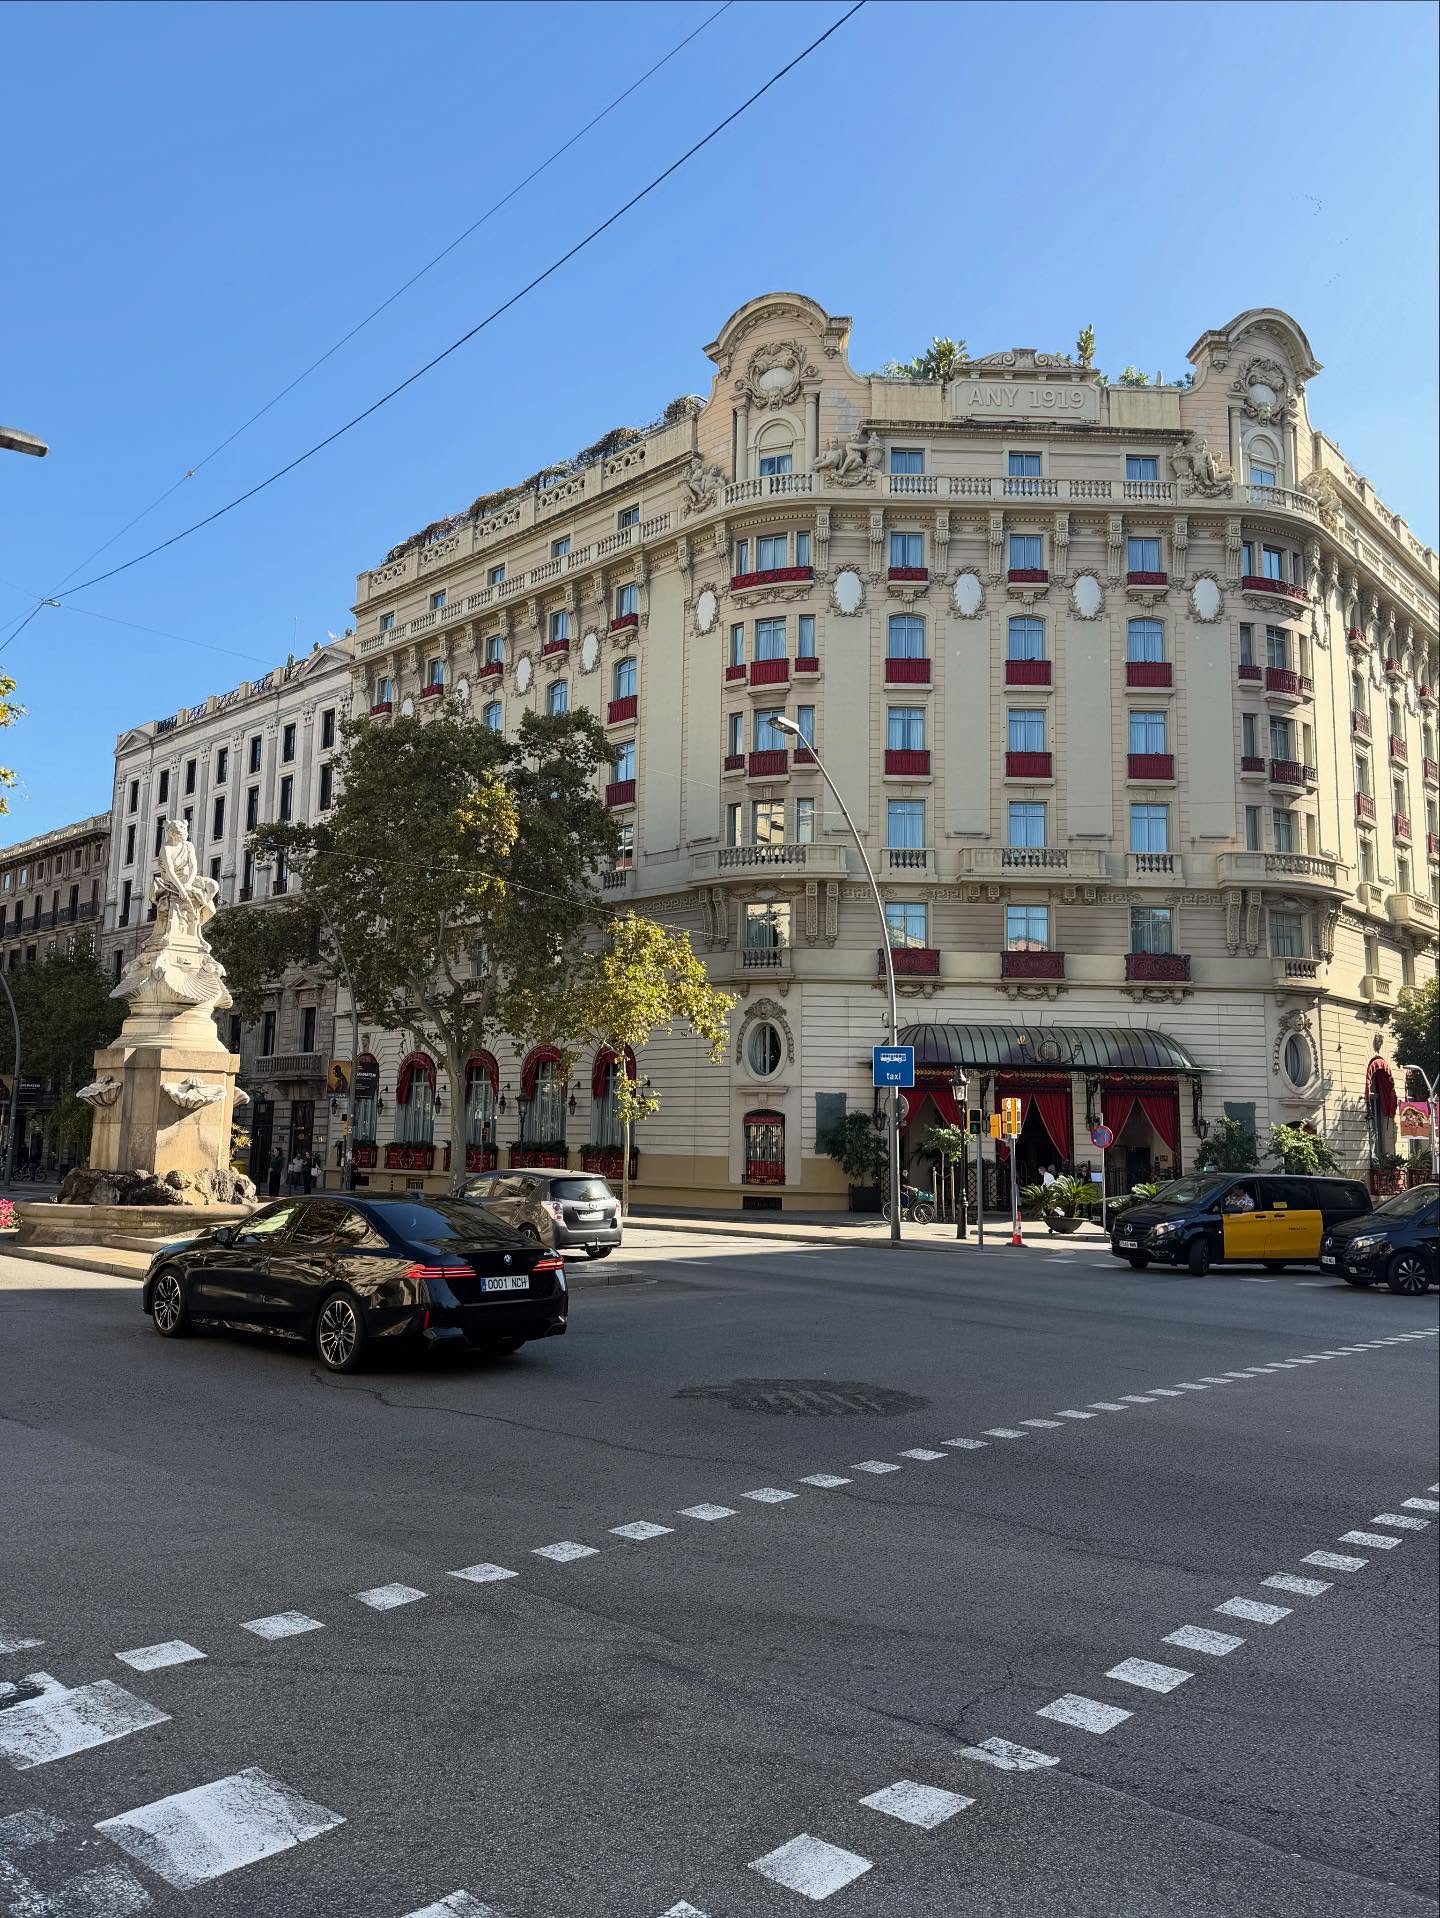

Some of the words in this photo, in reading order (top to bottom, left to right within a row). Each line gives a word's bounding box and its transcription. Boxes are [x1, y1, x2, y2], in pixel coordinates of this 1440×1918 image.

[968, 386, 1019, 407] ANY
[1029, 389, 1085, 409] 1919
[886, 1072, 901, 1080] taxi
[487, 1279, 508, 1290] 0001
[511, 1277, 527, 1289] NCH
